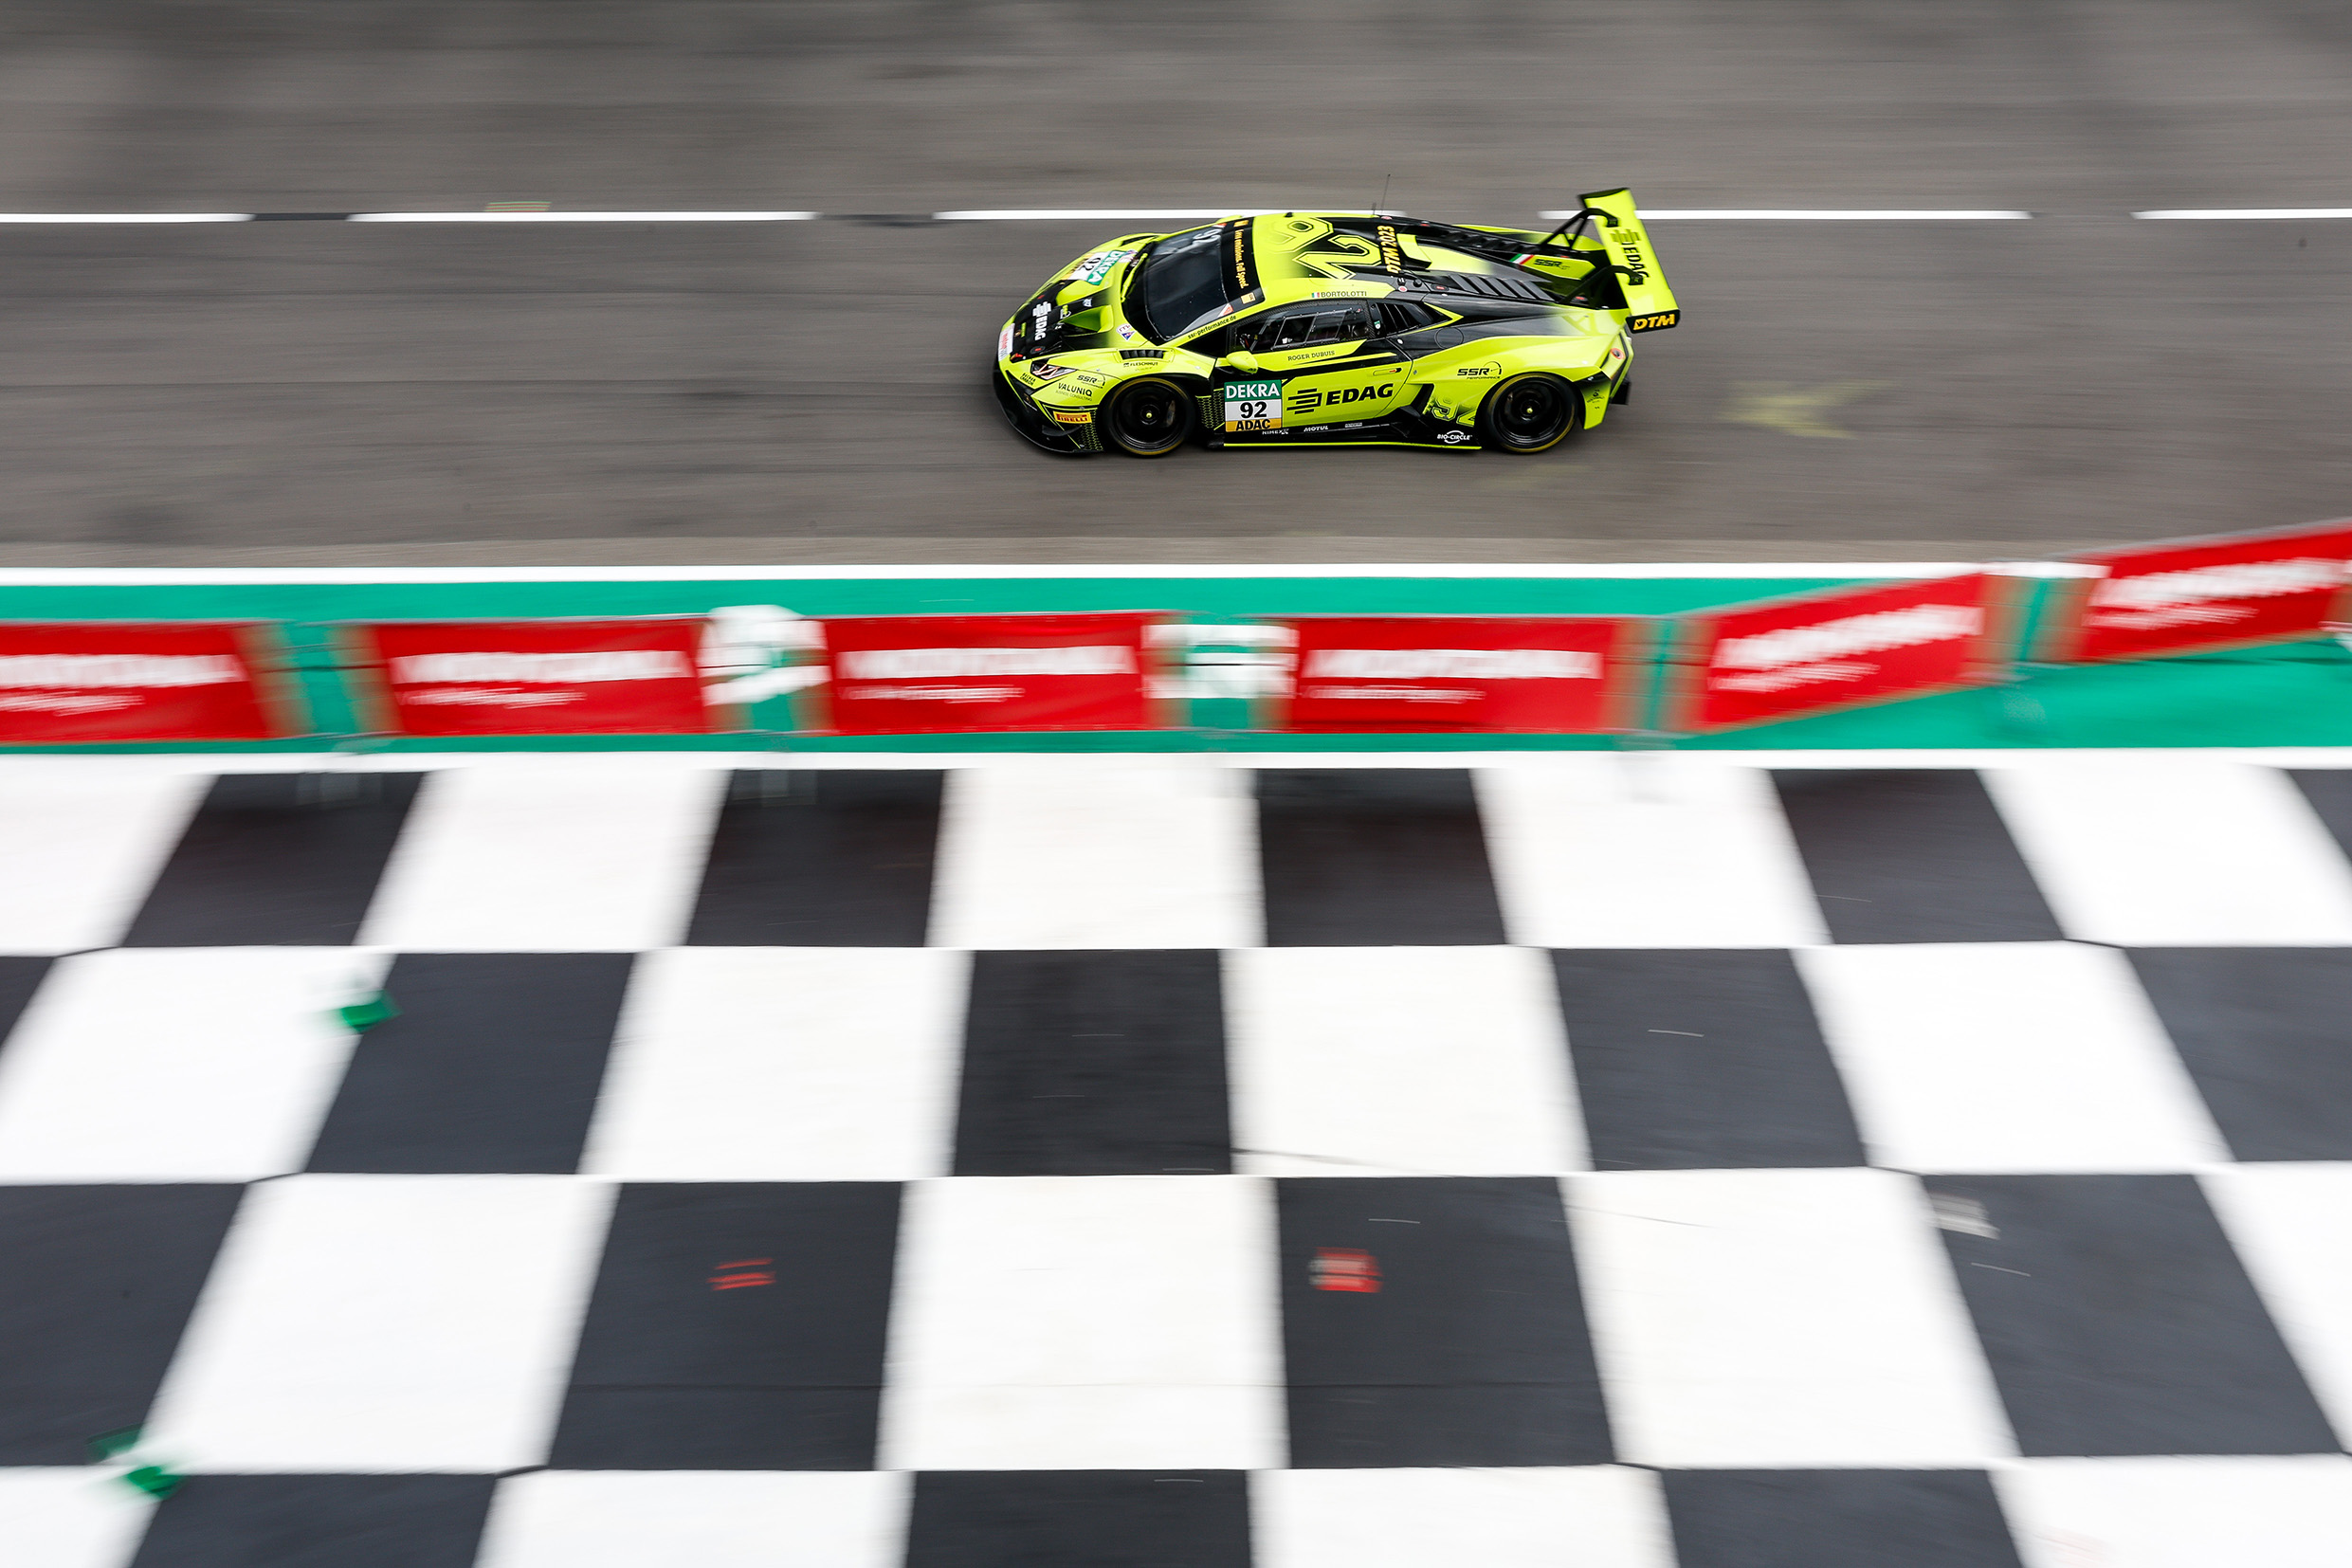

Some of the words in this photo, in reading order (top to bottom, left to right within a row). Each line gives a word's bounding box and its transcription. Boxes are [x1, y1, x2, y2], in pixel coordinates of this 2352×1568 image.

[1377, 225, 1398, 246] 2023
[1234, 239, 1245, 263] emissions.
[1382, 246, 1401, 274] DTM
[1034, 315, 1048, 340] EDAG
[1187, 315, 1237, 339] ssr-performance.de
[1632, 314, 1675, 330] DTM
[1287, 353, 1310, 361] ROGER
[1311, 350, 1335, 358] DUBUIS
[1077, 374, 1098, 384] SSR
[1058, 382, 1093, 397] VALUNIQ
[1226, 382, 1280, 399] DEKRA
[1326, 383, 1394, 406] EDAG
[1240, 401, 1267, 419] 92
[1235, 419, 1271, 431] ADAC
